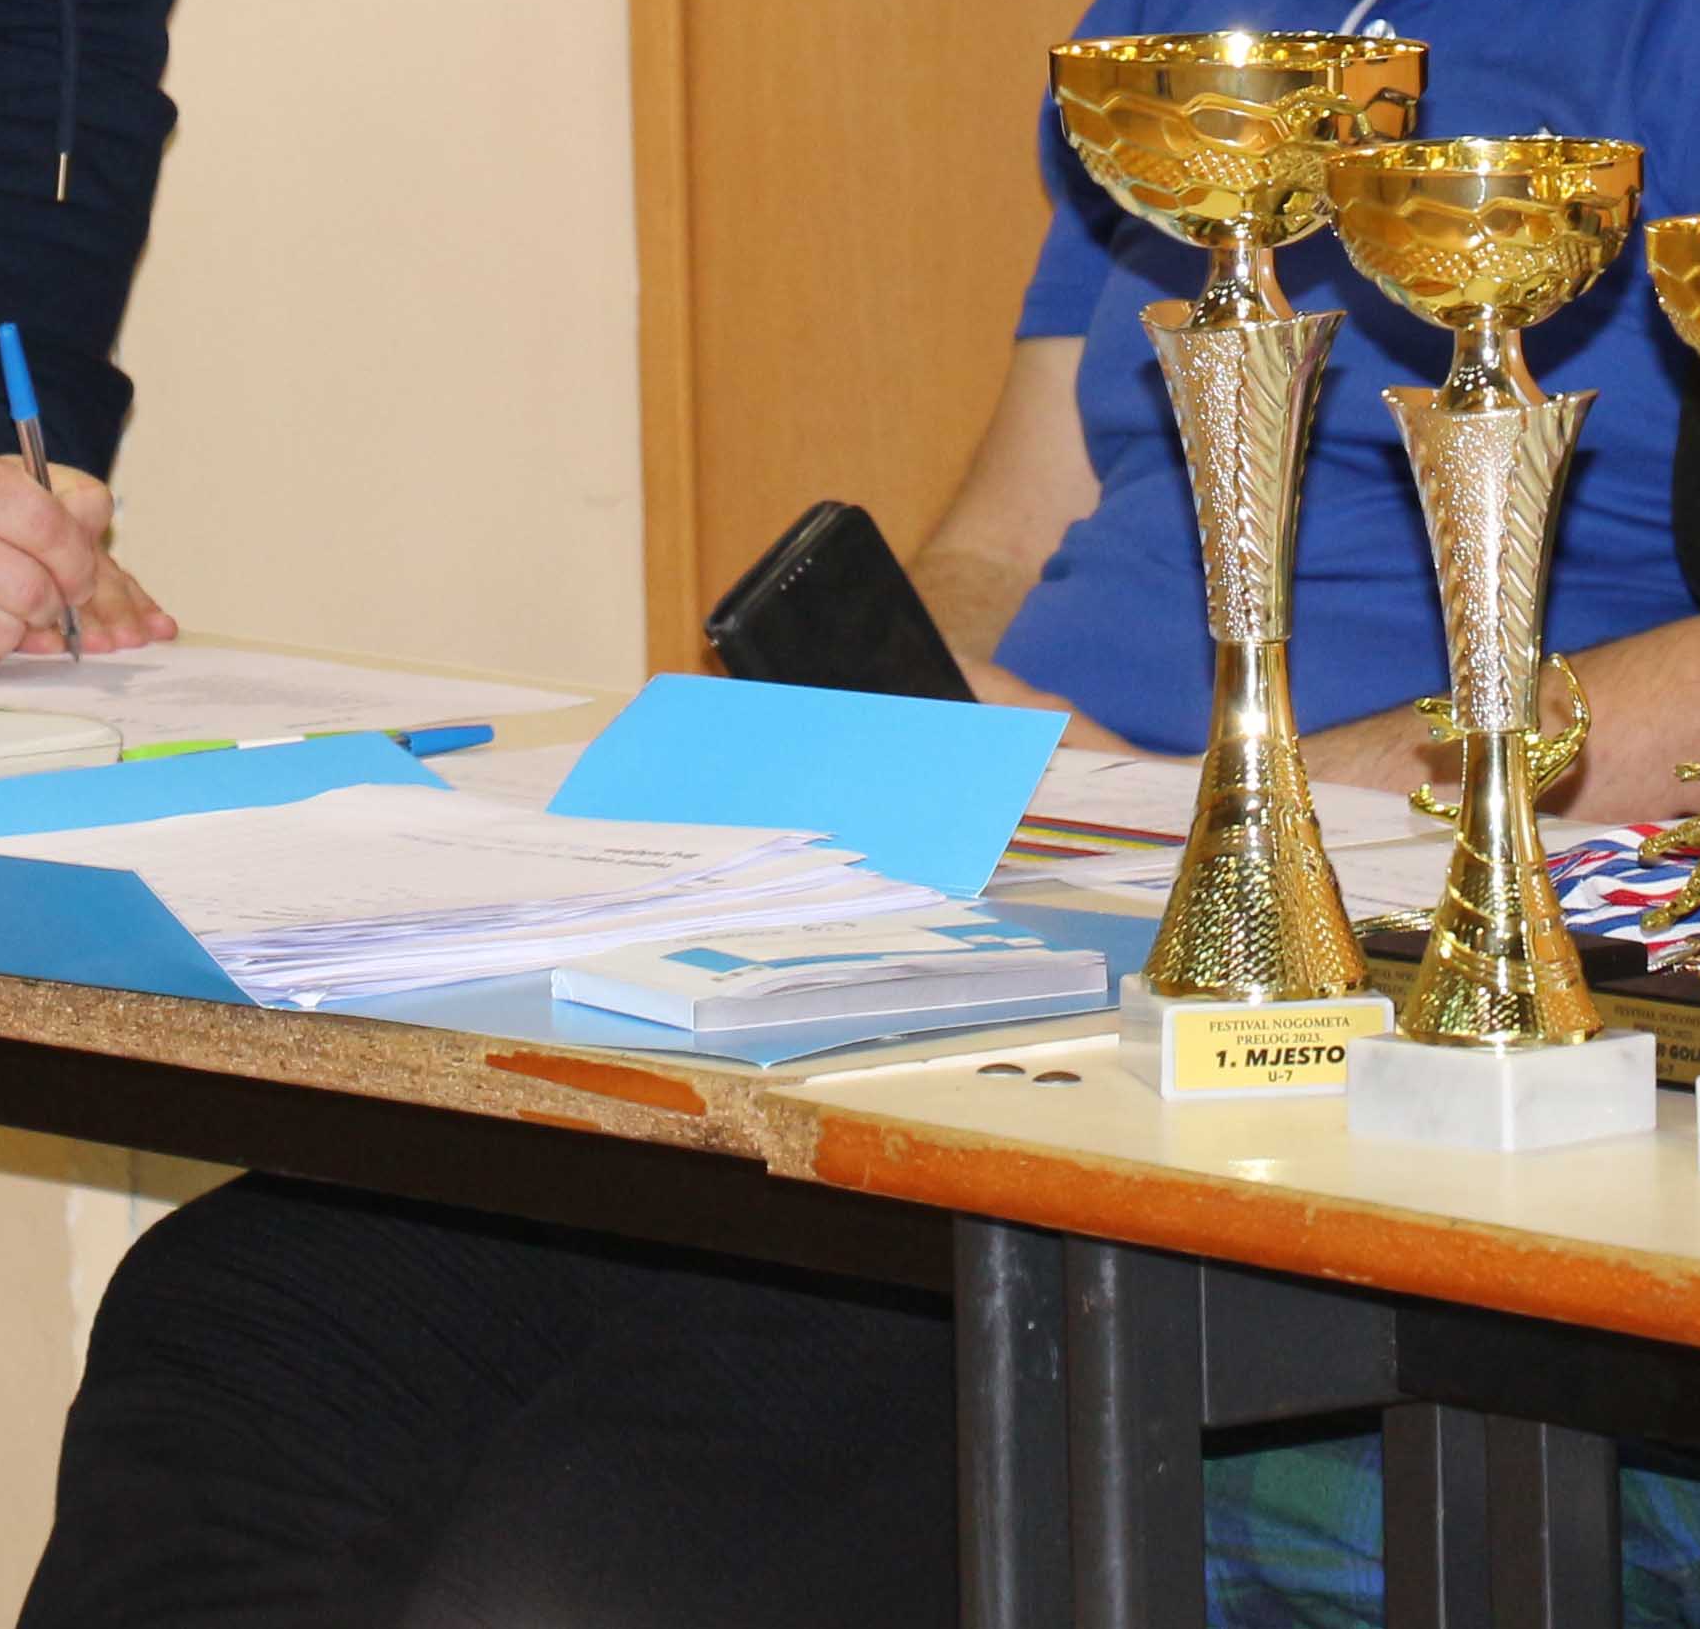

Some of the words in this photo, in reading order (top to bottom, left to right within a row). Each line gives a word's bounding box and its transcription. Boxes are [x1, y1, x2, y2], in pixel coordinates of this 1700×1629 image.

[1209, 1019, 1269, 1032] FESTIVAL
[1272, 1016, 1351, 1029] NOGOMETA
[1236, 1033, 1289, 1045] PRELOG
[1292, 1032, 1324, 1044] 2023.
[1215, 1050, 1237, 1068] 1.
[1245, 1045, 1346, 1068] MJESTO
[1267, 1069, 1293, 1082] U-7
